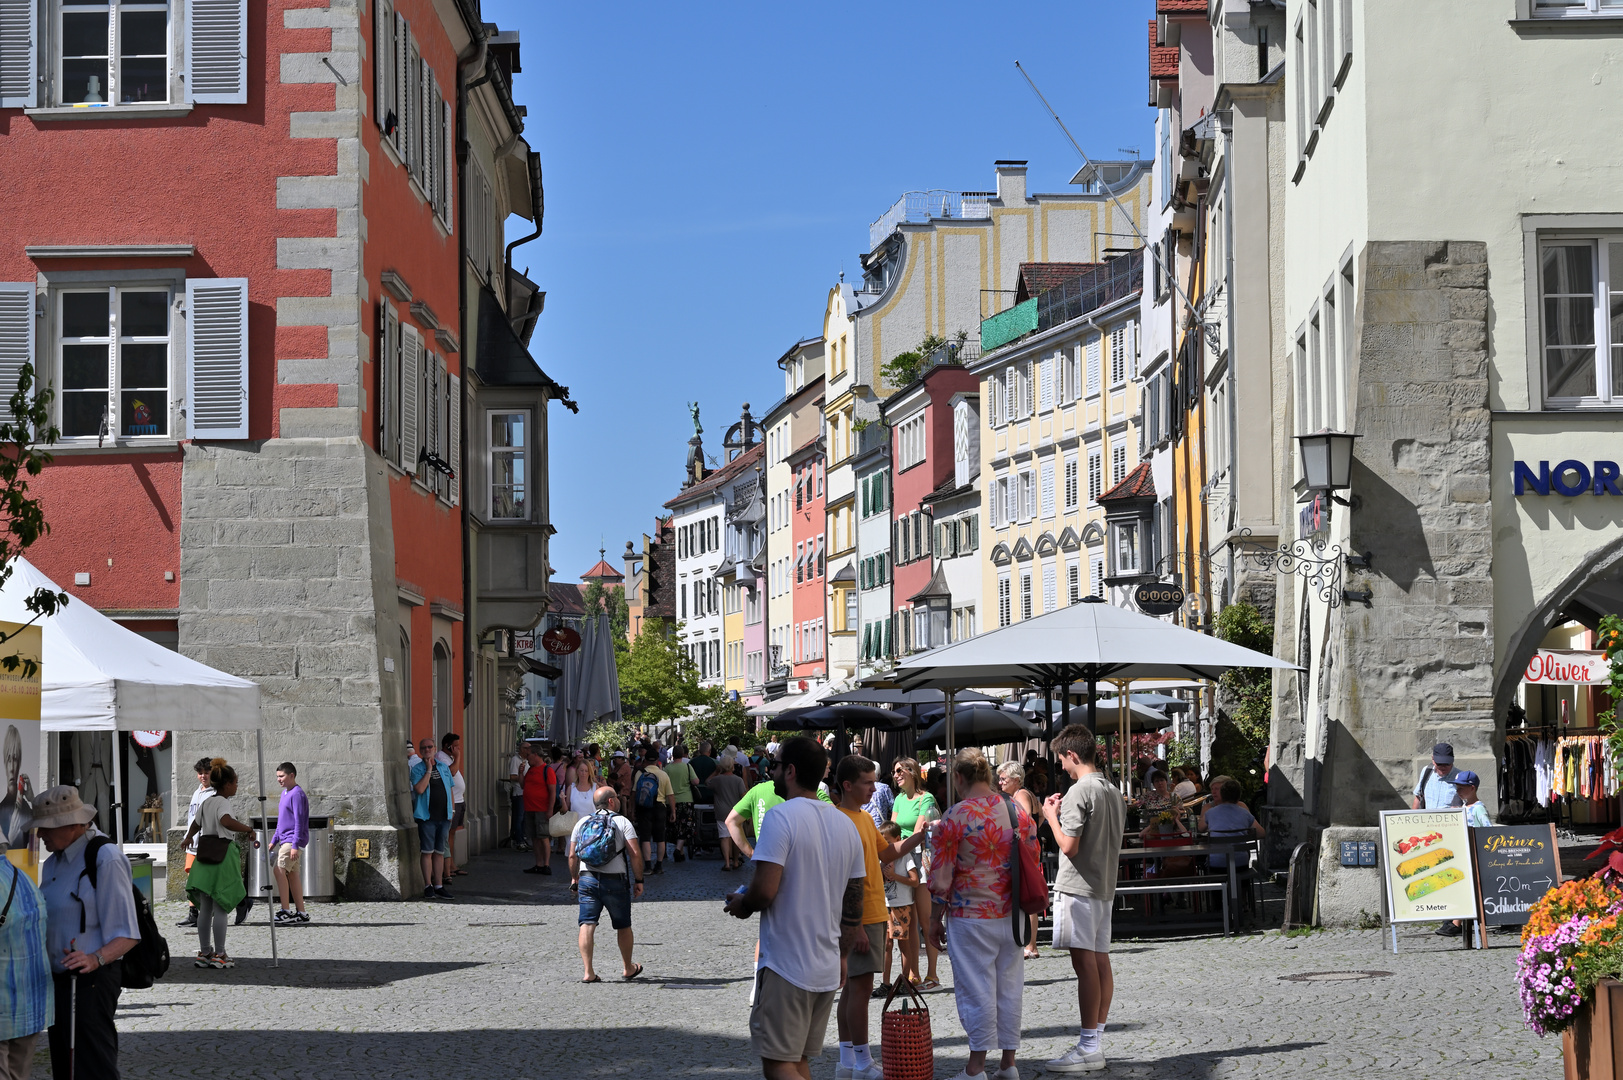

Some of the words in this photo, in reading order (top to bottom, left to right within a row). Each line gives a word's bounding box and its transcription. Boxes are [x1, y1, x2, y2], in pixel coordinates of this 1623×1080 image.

[1514, 459, 1623, 497] NOR
[1139, 591, 1182, 602] HUGO
[1389, 814, 1459, 825] SARGLADEN
[1484, 835, 1544, 853] Prinz
[1415, 904, 1425, 912] 25
